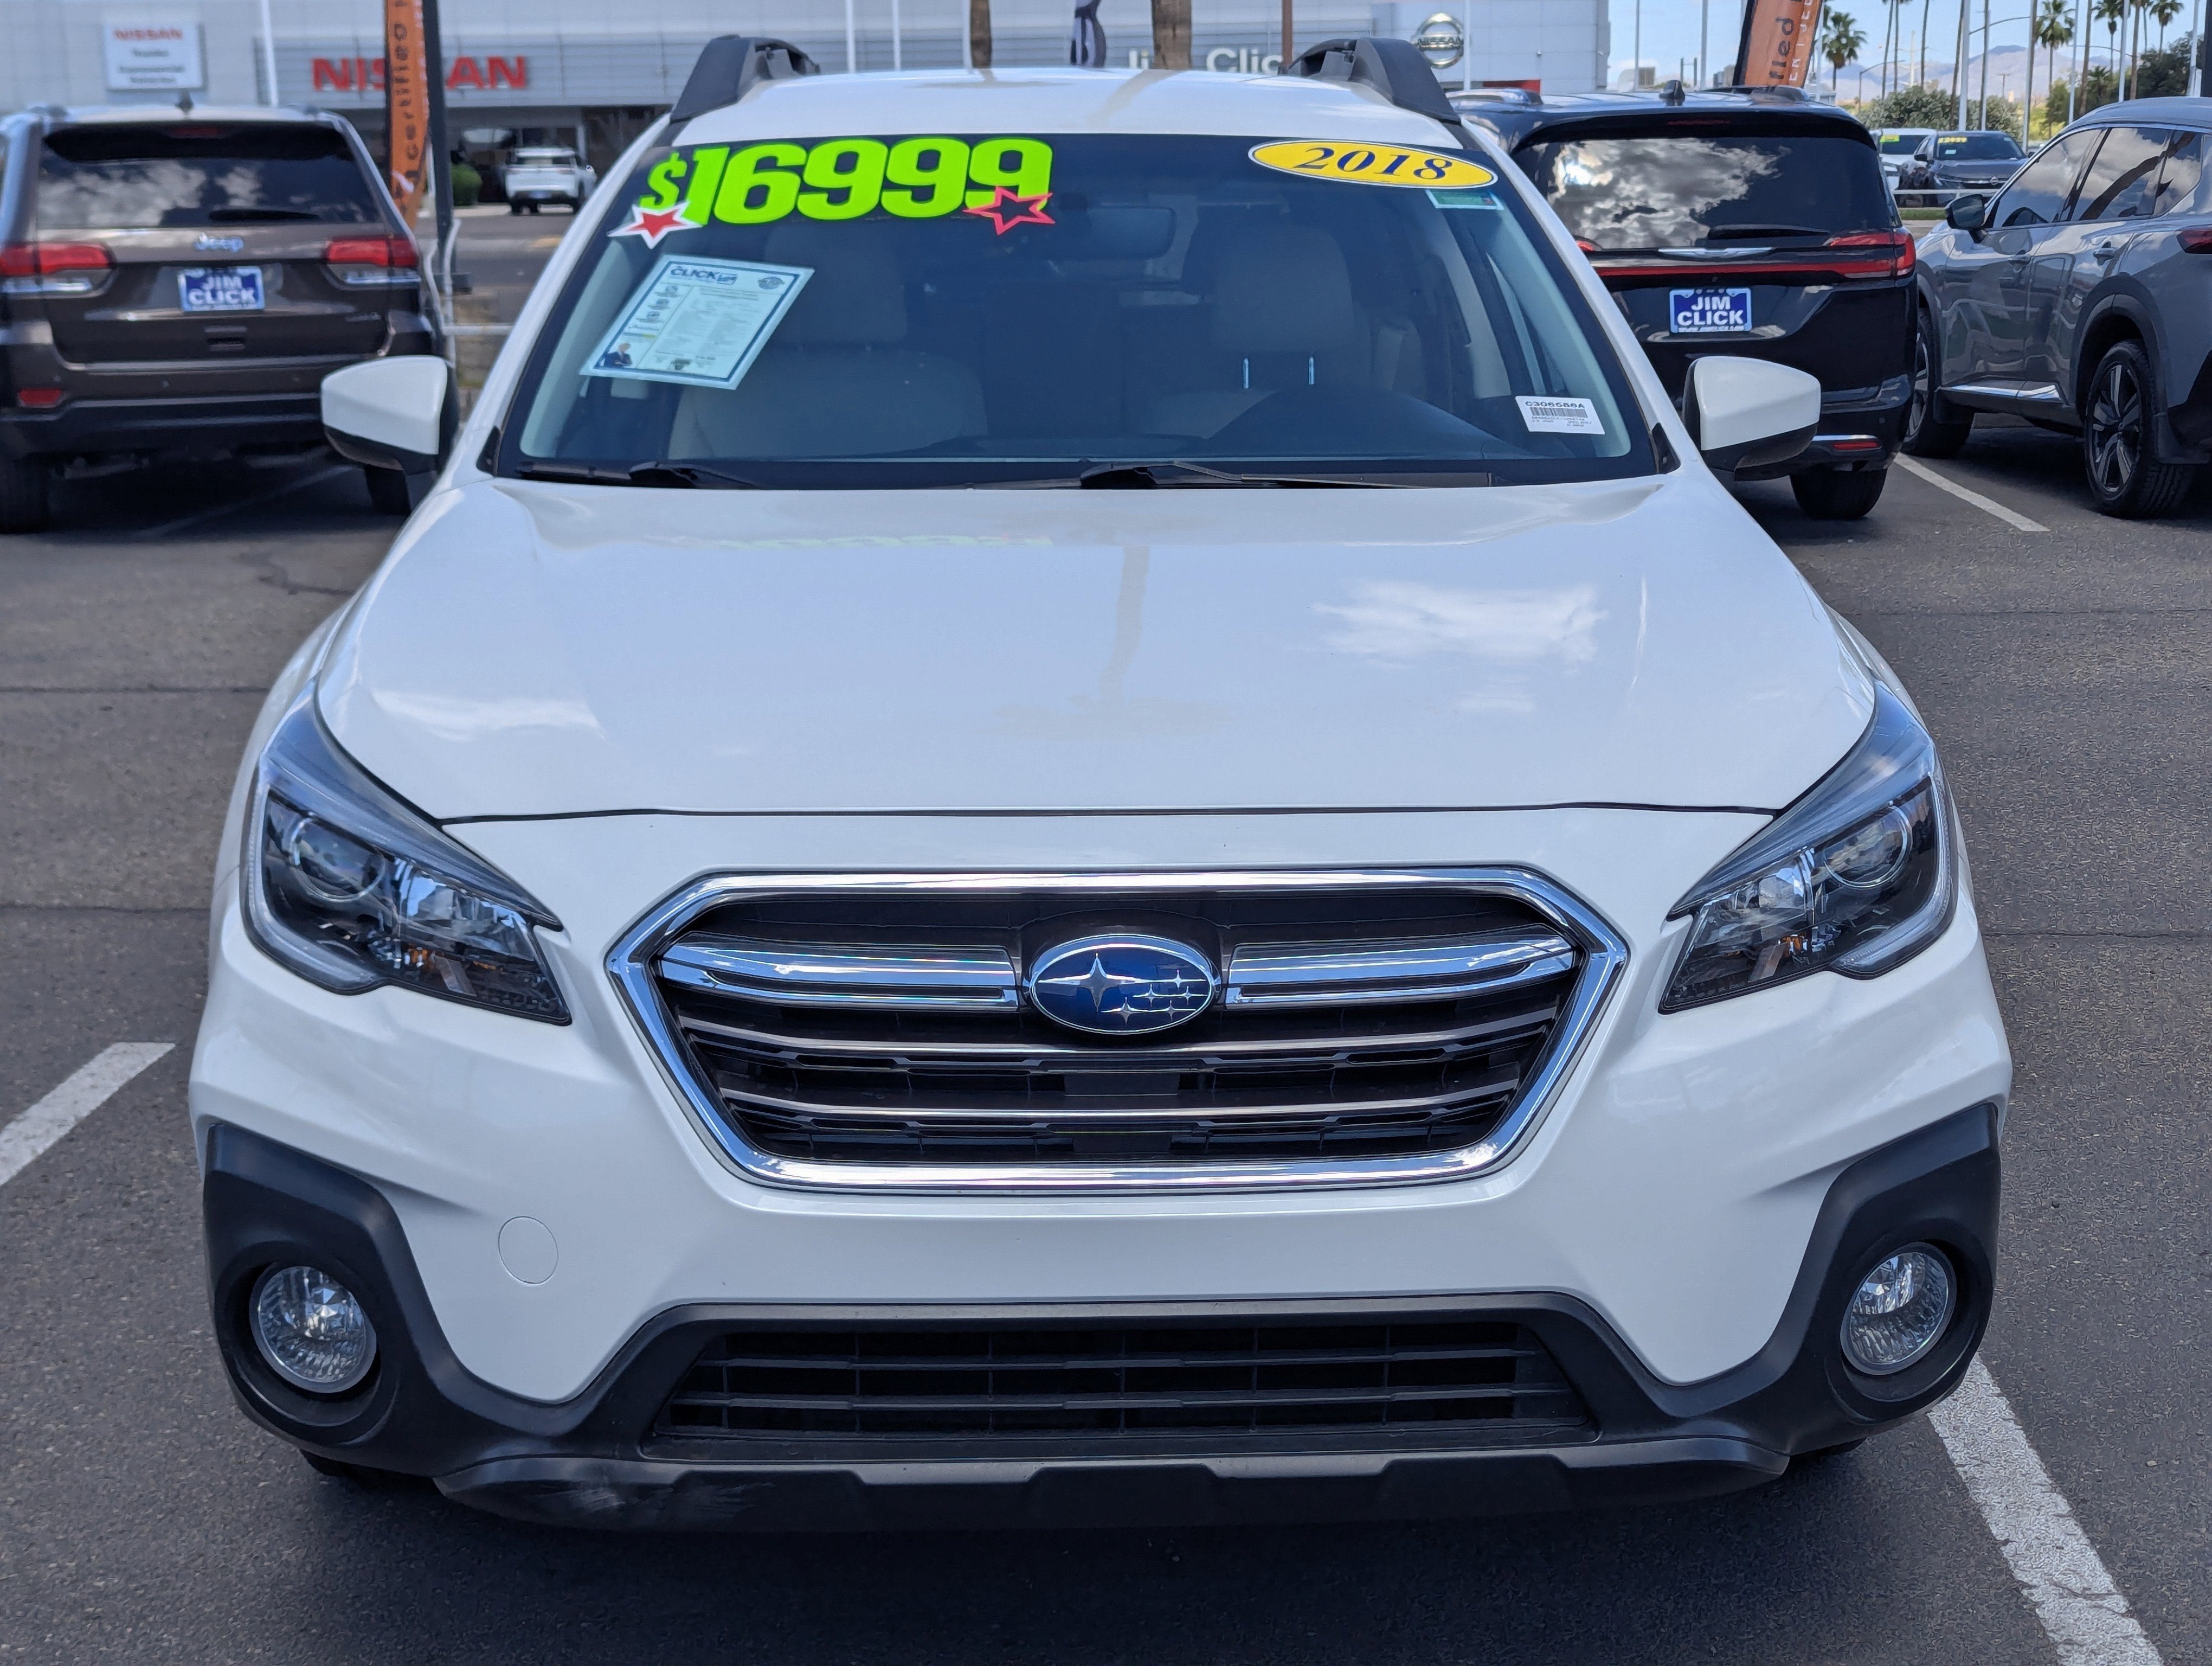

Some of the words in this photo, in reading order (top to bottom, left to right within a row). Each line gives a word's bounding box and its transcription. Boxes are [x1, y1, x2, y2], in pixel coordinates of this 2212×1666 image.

[113, 29, 183, 40] NISSAN
[312, 56, 526, 91] NIAN
[1293, 146, 1454, 180] 2018
[639, 137, 1053, 224] $16999
[195, 233, 244, 252] Jeep
[201, 276, 242, 291] JIM
[189, 287, 256, 305] CLICK
[1691, 296, 1731, 311] JIM
[1677, 310, 1744, 325] CLICK
